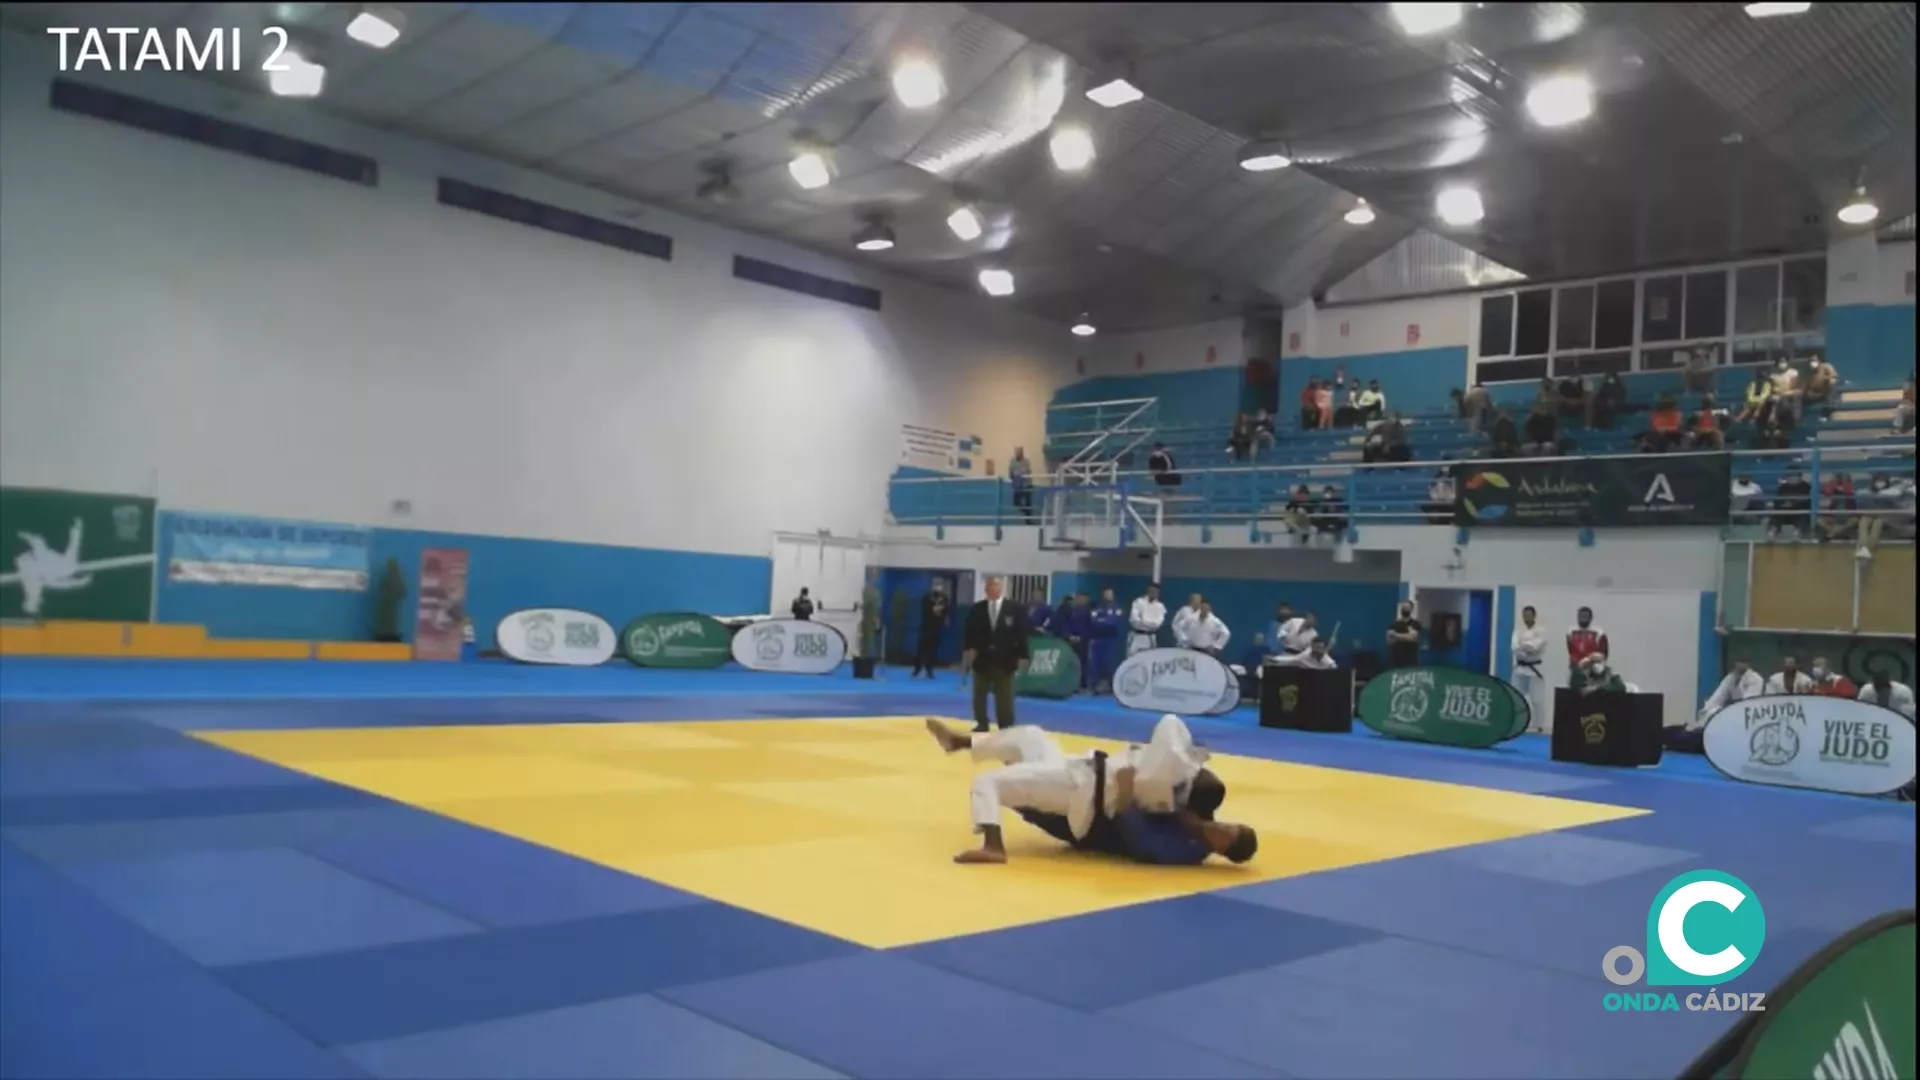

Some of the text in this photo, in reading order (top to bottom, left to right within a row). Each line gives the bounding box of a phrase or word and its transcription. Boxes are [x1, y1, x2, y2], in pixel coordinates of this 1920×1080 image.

[1446, 685, 1492, 703] VIVE EL
[1439, 697, 1489, 720] JUDO
[1823, 719, 1893, 740] VIVE EL
[1818, 737, 1890, 761] JUDO
